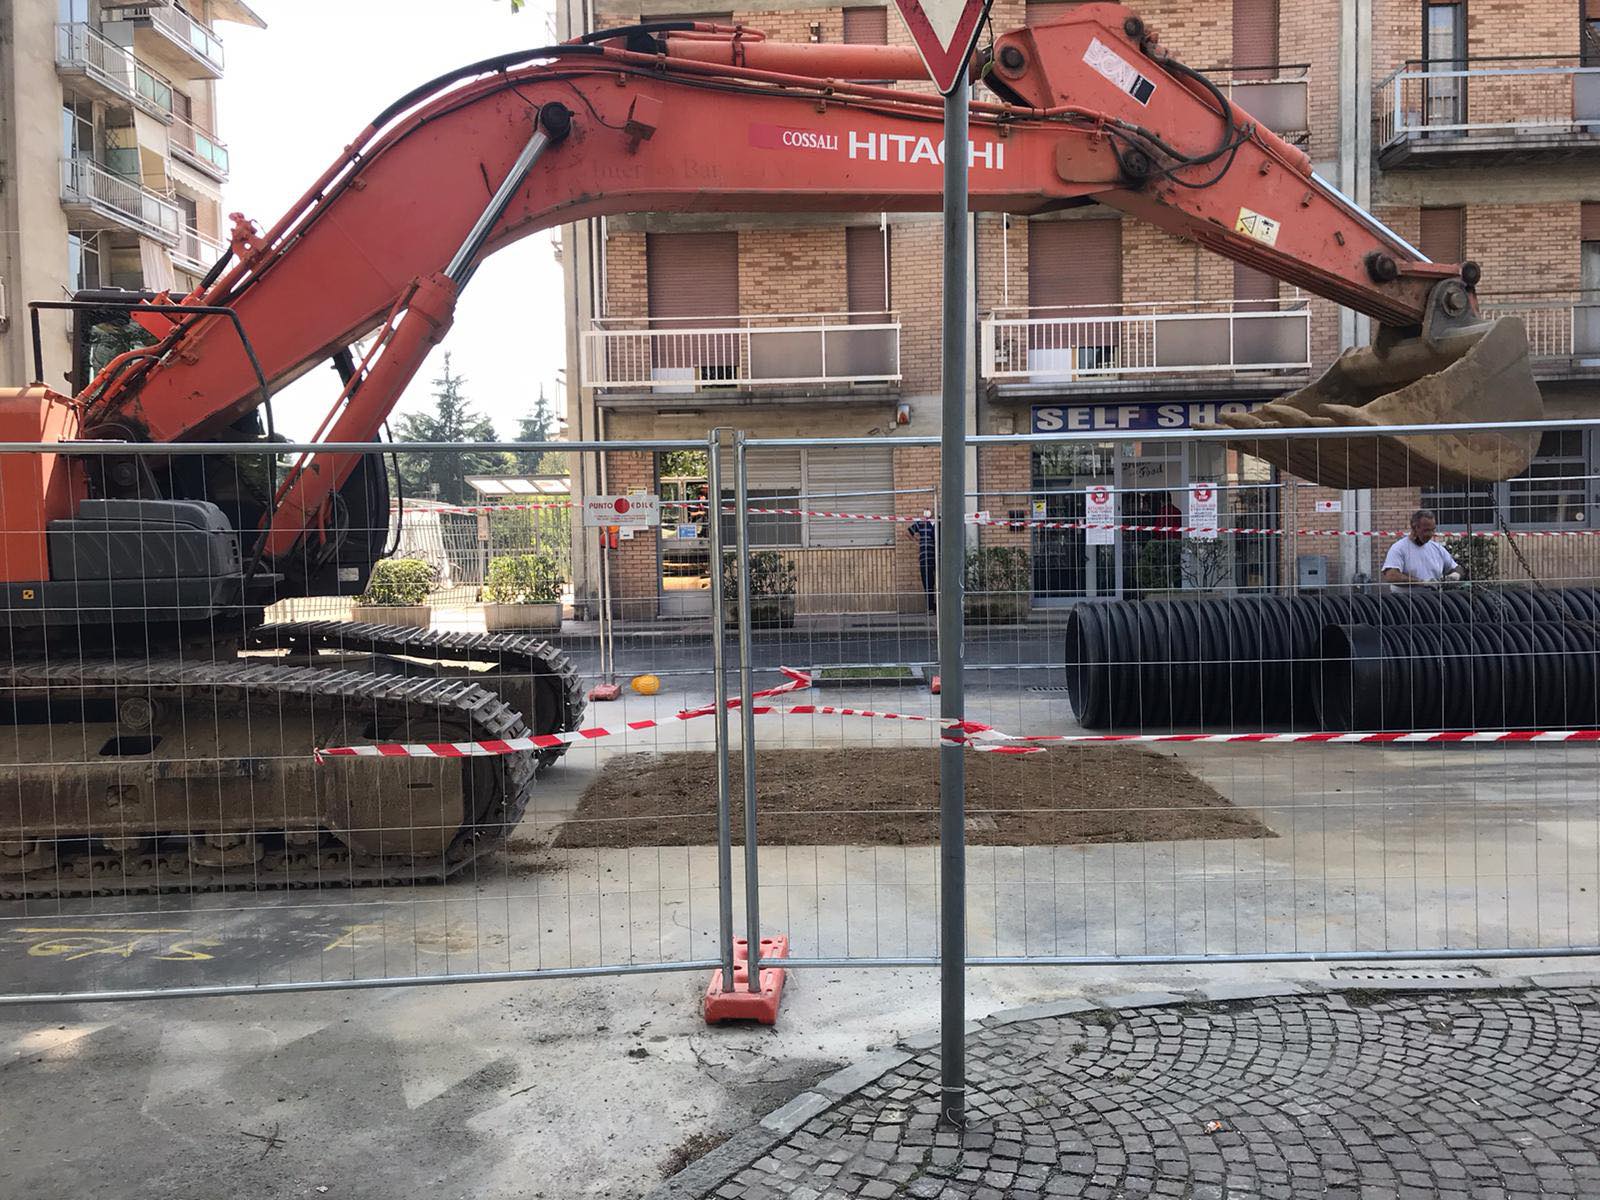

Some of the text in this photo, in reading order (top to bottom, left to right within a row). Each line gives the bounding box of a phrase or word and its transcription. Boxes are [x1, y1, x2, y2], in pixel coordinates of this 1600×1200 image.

[782, 130, 838, 151] COSSALI
[849, 131, 1004, 170] HITAHI
[1037, 403, 1264, 431] SELF SHO
[631, 501, 654, 509] EDILE
